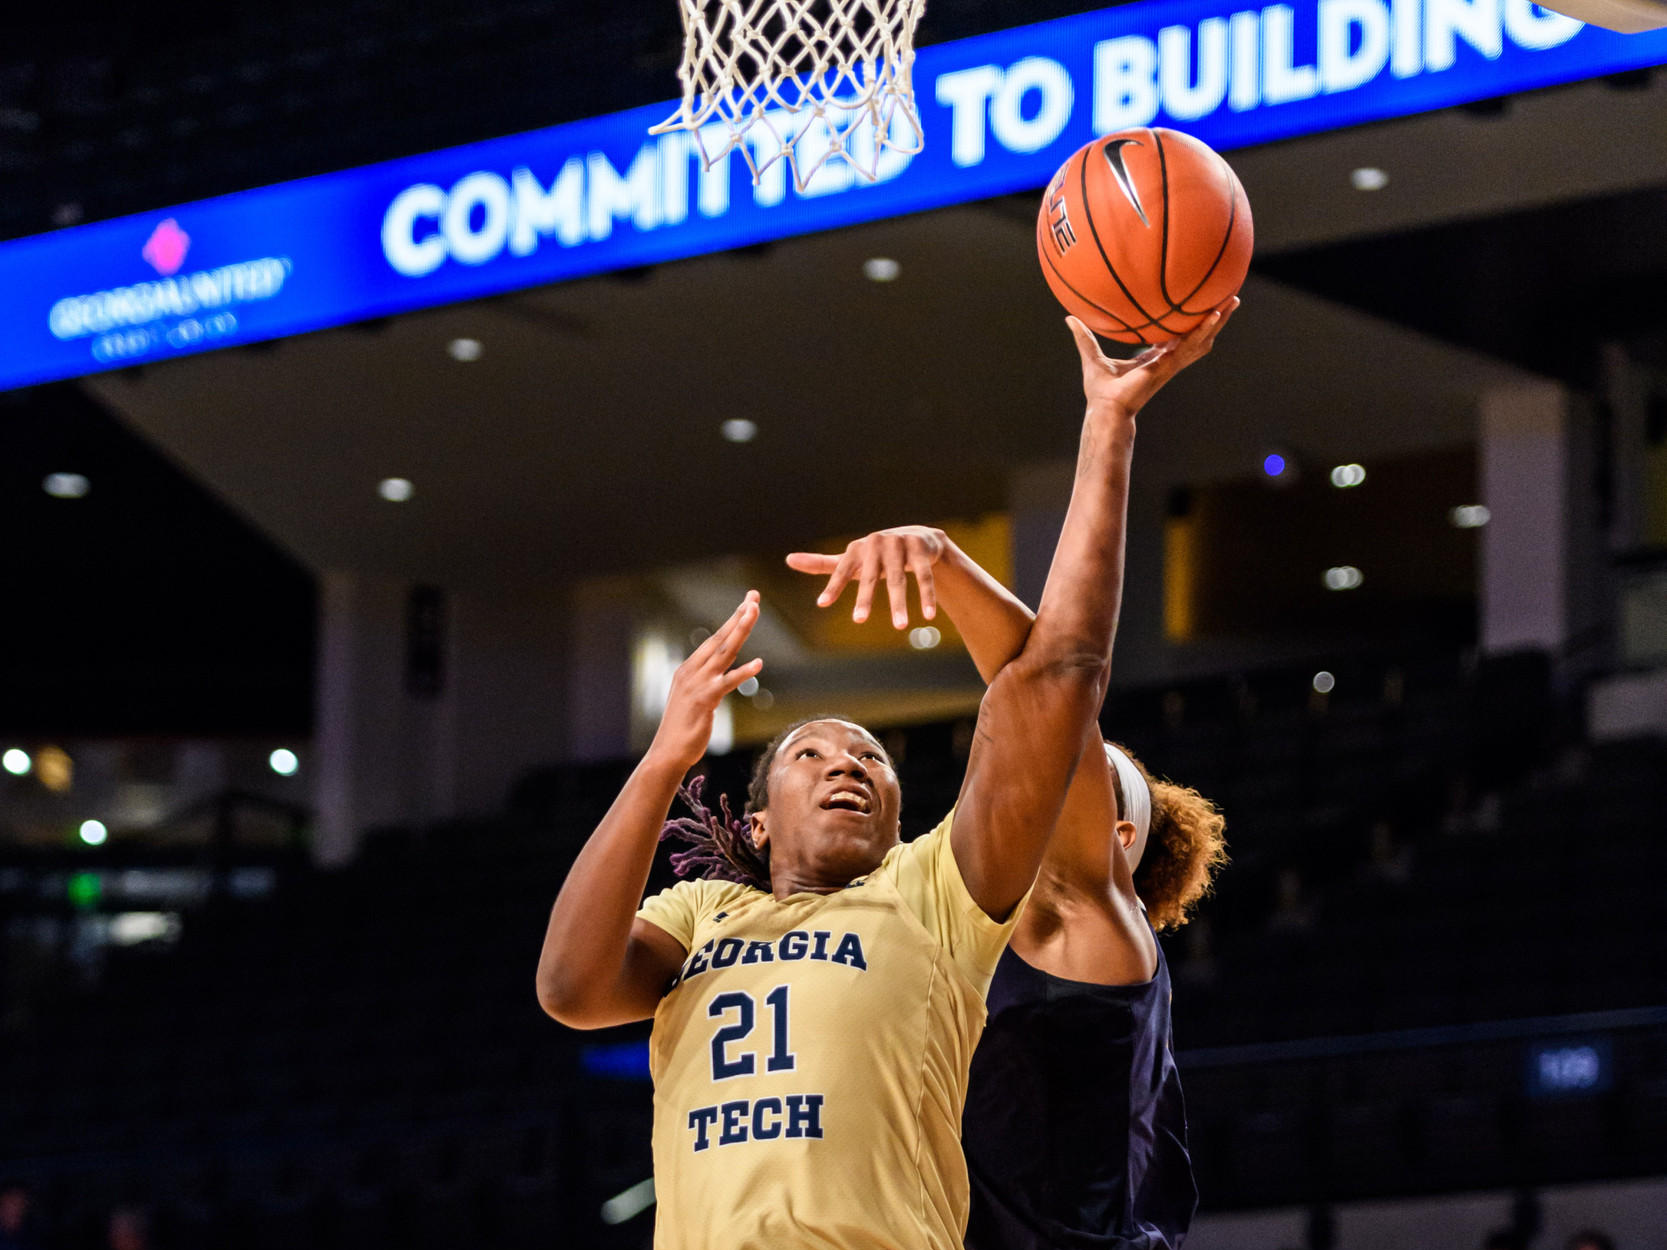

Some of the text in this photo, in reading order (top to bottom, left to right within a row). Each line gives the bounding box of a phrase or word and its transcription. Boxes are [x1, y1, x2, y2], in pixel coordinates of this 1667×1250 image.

[381, 94, 922, 276] COMMITTED
[935, 56, 1075, 167] TO
[664, 930, 868, 998] EORGIA
[706, 983, 796, 1084] 21
[688, 1094, 824, 1153] TECH
